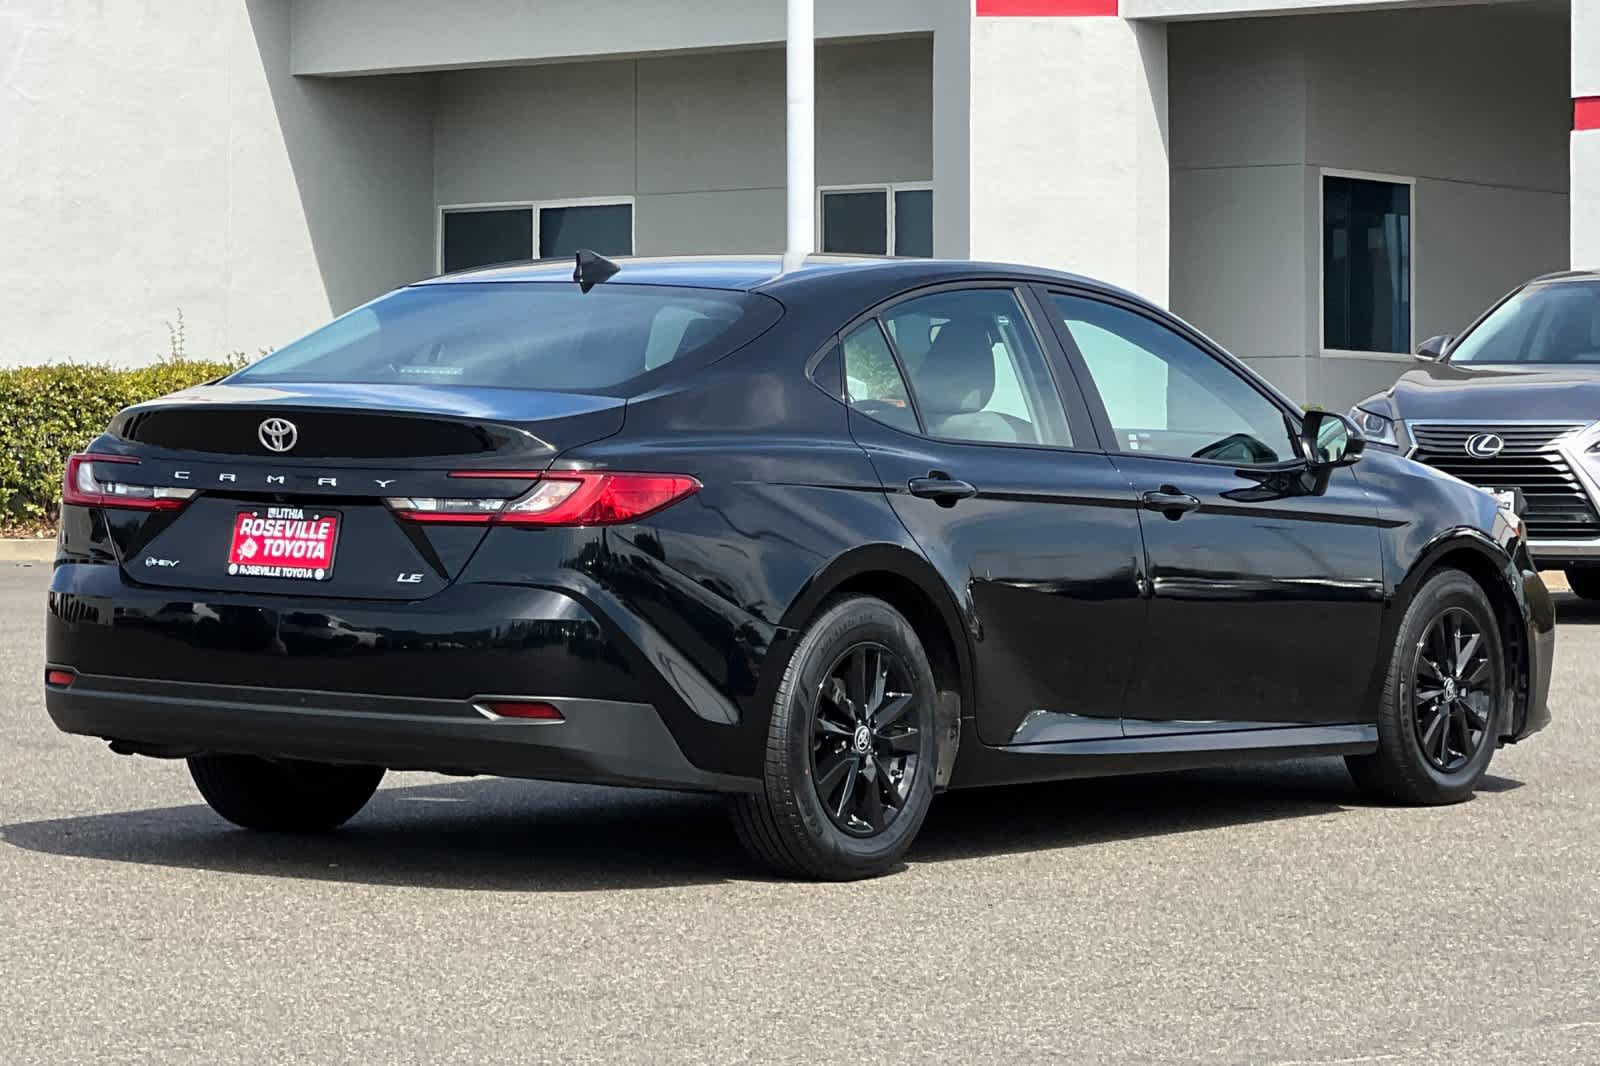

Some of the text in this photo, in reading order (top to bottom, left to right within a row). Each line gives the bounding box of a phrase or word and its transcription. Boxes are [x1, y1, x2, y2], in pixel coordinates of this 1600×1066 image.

[174, 470, 397, 488] CAMRY
[277, 508, 303, 519] LITHIA
[240, 518, 330, 539] ROSEVILLE
[263, 539, 325, 560] TOYOTA
[282, 568, 313, 579] TOYOTA
[396, 572, 424, 583] LE
